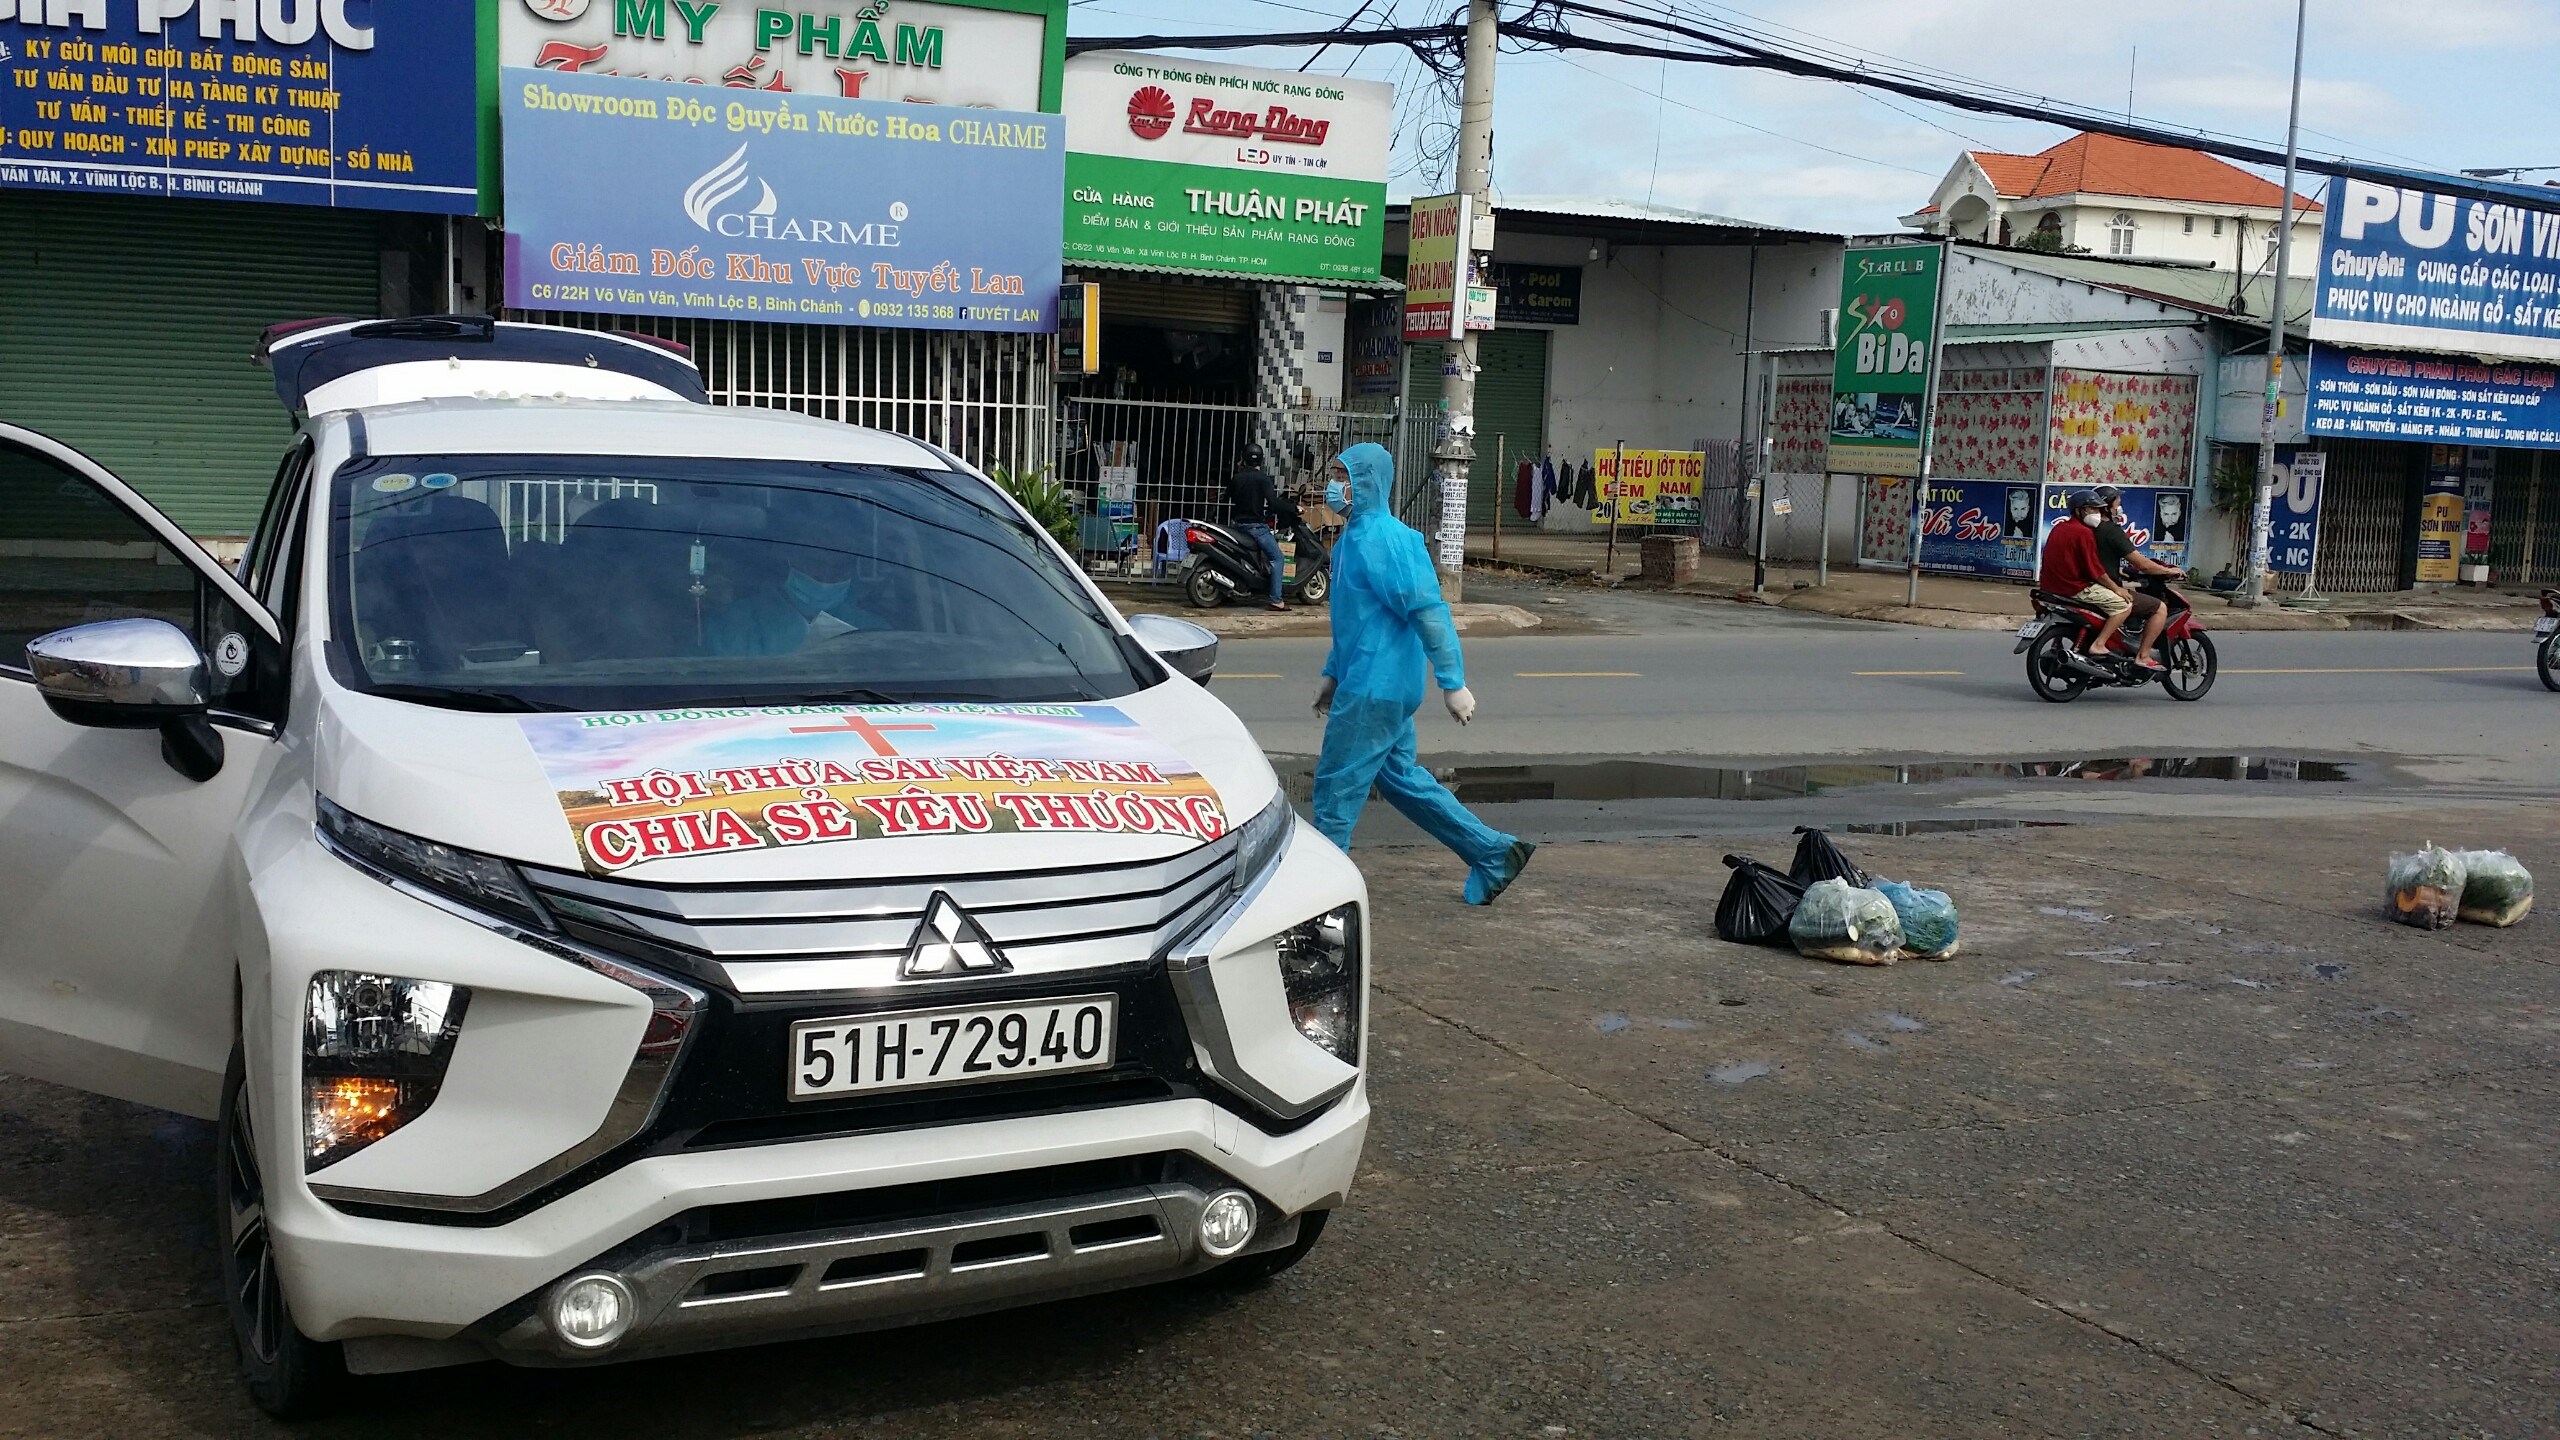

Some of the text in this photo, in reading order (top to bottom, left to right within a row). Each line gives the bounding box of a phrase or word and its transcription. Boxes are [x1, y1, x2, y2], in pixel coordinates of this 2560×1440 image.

[756, 0, 945, 68] PHẨM
[25, 36, 51, 58] KÝ
[60, 36, 94, 62] GỬI
[102, 42, 137, 65] MÔI
[145, 44, 183, 68] GIỚI
[190, 45, 224, 72] BẤT
[232, 52, 282, 78] ĐỘNG
[289, 54, 327, 79] SẢN
[13, 65, 341, 113] TƯ VẤN ĐẦU TƯ HẠ TẦNG KỸ THUẬT
[1113, 62, 1344, 101] CÔNG TY BÓNG ĐÈN PHÍCH NƯỚC RẠNG ĐÔNG
[36, 96, 310, 137] TƯ VẤN THIẾT KẾ THI CÔNG
[524, 84, 1047, 150] Showroom Độc Quyền Nước Hoa CHARME
[19, 129, 55, 149] QUY
[64, 132, 125, 157] HOẠCH
[146, 137, 177, 156] XIN
[185, 137, 231, 160] PHÉP
[238, 140, 272, 163] XÂY
[280, 145, 330, 169] DỰNG
[347, 144, 371, 169] SỐ
[377, 150, 414, 172] NHÀ
[1237, 147, 1269, 165] LED
[1, 166, 28, 182] VĂN
[69, 174, 82, 186] X.
[86, 170, 118, 187] VĨNH
[121, 171, 146, 190] LỘC
[183, 175, 215, 193] BÌNH
[218, 176, 263, 195] CHÁNH
[1073, 186, 1368, 227] CỬA HÀNG THUẬN PHÁT
[2340, 178, 2525, 255] PU SƠN
[716, 213, 901, 247] CHARME
[1083, 212, 1355, 247] ĐIỂM BÁN & GIỚI THIỆU SẢN PHẨM RẠNG ĐÔNG
[550, 242, 1024, 298] Giám Đốc Khu Vực Tuyết Lan
[1529, 273, 1561, 287] Pool
[2331, 249, 2556, 299] Chuyên: CUNG CẤP CÁC LOẠI
[595, 287, 614, 302] Võ
[617, 288, 645, 304] Văn
[649, 290, 679, 307] Vân,
[683, 292, 715, 307] Vĩnh
[718, 294, 744, 311] Lộc
[766, 297, 797, 312] Bình
[800, 298, 843, 314] Chánh
[873, 304, 904, 318] 0932
[907, 305, 930, 319] 135
[932, 306, 954, 320] 368
[968, 304, 1010, 321] TUYẾT
[1013, 308, 1039, 322] LAN
[1527, 293, 1572, 307] Carom
[2328, 288, 2542, 327] PHỤC VỤ CHO NGÀNH GỖ SẮT
[2319, 379, 2337, 392] SƠN
[2338, 381, 2360, 394] THƠM
[2364, 382, 2381, 395] SƠN
[2402, 385, 2419, 398] SƠN
[2510, 393, 2524, 405] CAO
[2523, 370, 2555, 391] LOẠI
[2318, 399, 2340, 414] PHỤC
[2431, 407, 2441, 418] 1K
[2446, 408, 2456, 419] 2K
[2461, 409, 2472, 420] PU
[2476, 410, 2487, 421] EX
[2334, 419, 2345, 430] AB
[2424, 425, 2434, 436] PE
[1621, 451, 1653, 478] TIẾU
[1679, 454, 1701, 477] TÓC
[1660, 482, 1691, 494] NAM
[1940, 486, 1964, 503] TÓC
[2288, 522, 2312, 540] 2K
[2286, 547, 2309, 567] NC
[583, 712, 648, 730] HỘI
[1010, 705, 1082, 717] NAM
[606, 753, 1167, 804] HỘI THỪA SAI VIỆT NAM
[588, 787, 1226, 866] CHIA SẺ YÊU THƯƠNG
[803, 1005, 1104, 1088] 51H-729.40
